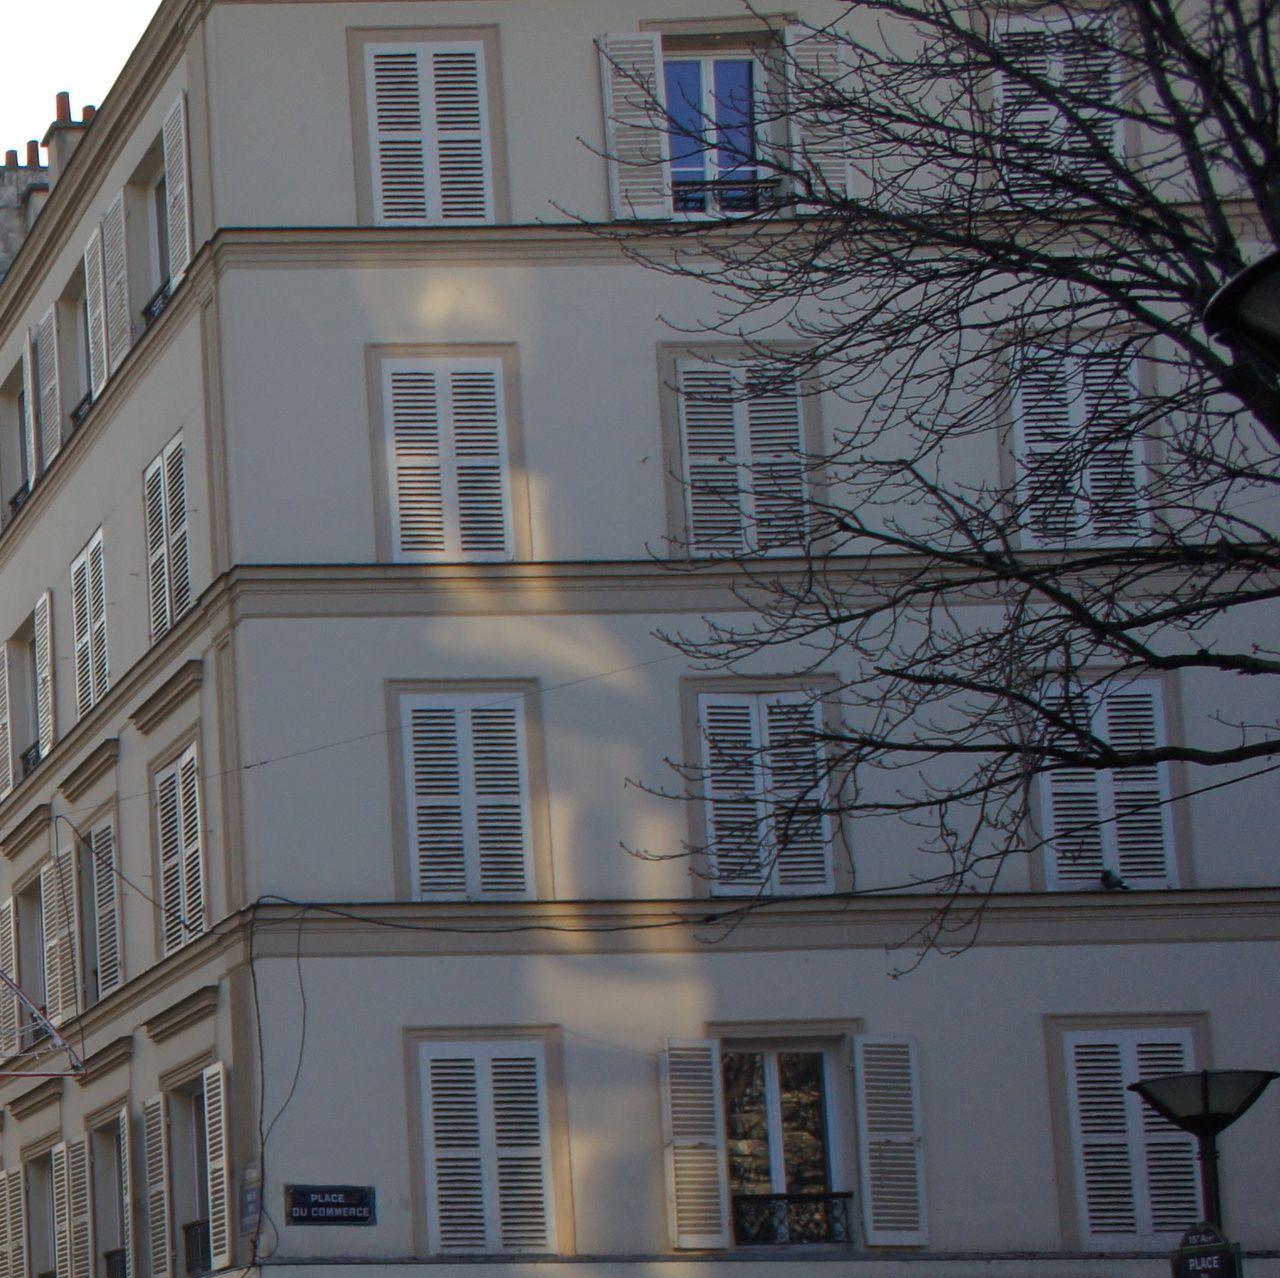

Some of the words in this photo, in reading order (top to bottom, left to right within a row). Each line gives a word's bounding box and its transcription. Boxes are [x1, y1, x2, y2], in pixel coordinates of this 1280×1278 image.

[310, 1194, 345, 1203] PLACE
[292, 1207, 308, 1217] DU
[311, 1207, 370, 1217] COMMERCE
[1188, 1256, 1220, 1270] PLACE
